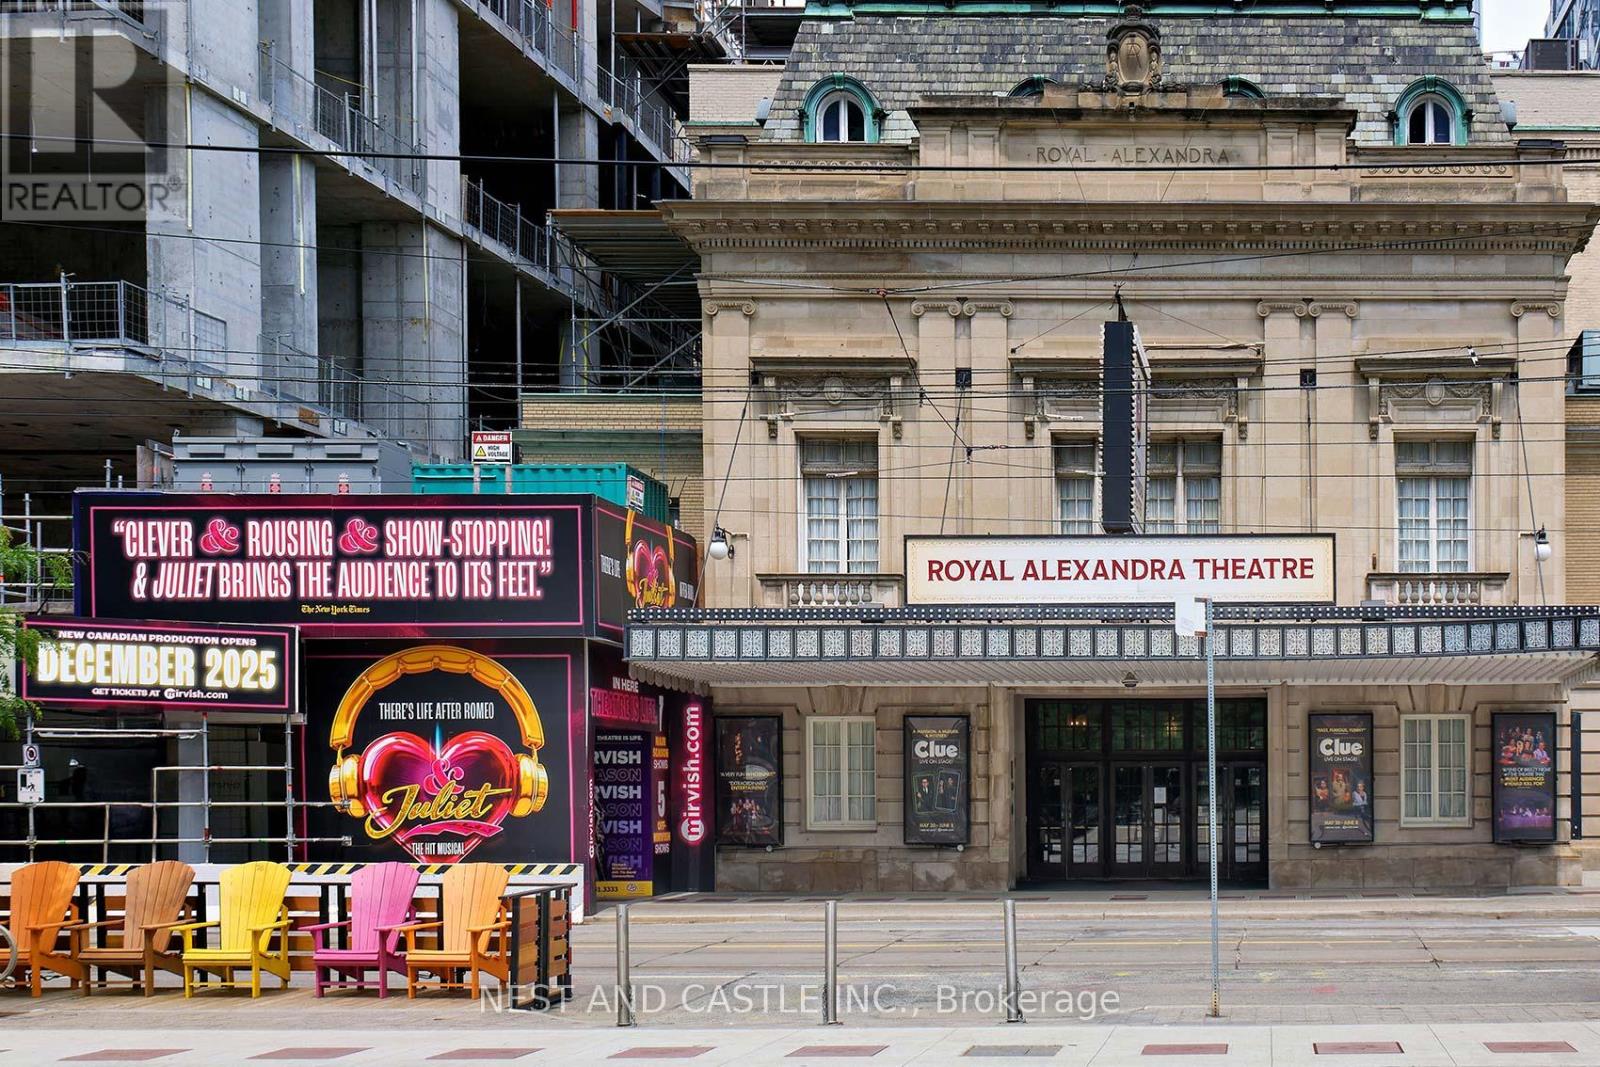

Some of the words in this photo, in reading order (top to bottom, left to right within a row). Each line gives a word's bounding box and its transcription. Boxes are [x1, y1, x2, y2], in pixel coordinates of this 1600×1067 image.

[1036, 147, 1096, 163] ROYAL
[1111, 147, 1229, 163] ALEXANDRA
[482, 434, 508, 442] DANGER
[200, 519, 239, 553] &
[248, 520, 333, 557] ROUSING
[339, 518, 378, 553] &
[385, 519, 551, 556] SHOW-STOPPING!
[927, 559, 1014, 582] ROYAL
[1021, 558, 1186, 582] ALEXANDRA
[1193, 557, 1314, 580] THEATRE
[133, 562, 147, 598] &
[153, 562, 216, 598] JULIET
[219, 562, 291, 598] BRINGS
[297, 561, 332, 598] THE
[337, 561, 430, 598] AUDIENCE
[435, 561, 457, 597] TO
[464, 561, 492, 597] ITS
[301, 604, 315, 614] The
[315, 604, 330, 614] New
[330, 604, 348, 615] York
[348, 604, 370, 614] Times
[58, 630, 85, 641] NEW
[86, 631, 147, 643] CANADIAN
[149, 634, 219, 645] PRODUCTION
[221, 636, 257, 647] OPENS
[37, 641, 195, 687] DECEMBER
[205, 648, 276, 689] 2025
[92, 688, 110, 696] GET
[111, 688, 148, 698] TICKETS
[149, 689, 160, 698] AT
[164, 687, 229, 700] mirvish.com
[612, 676, 621, 690] IN
[621, 678, 639, 693] HERE
[379, 702, 415, 720] THERE'S
[416, 702, 434, 720] LIFE
[435, 702, 462, 720] AFTER
[464, 702, 495, 720] ROMEO
[914, 740, 959, 758] Clue
[1319, 738, 1363, 756] Clue
[423, 758, 465, 795] &
[681, 706, 705, 842] mirvish.com
[657, 780, 666, 818] 5
[364, 780, 513, 839] Juliet
[411, 842, 423, 856] THE
[424, 842, 436, 856] HIT
[437, 842, 466, 856] MUSICAL
[654, 843, 670, 854] SHOWS
